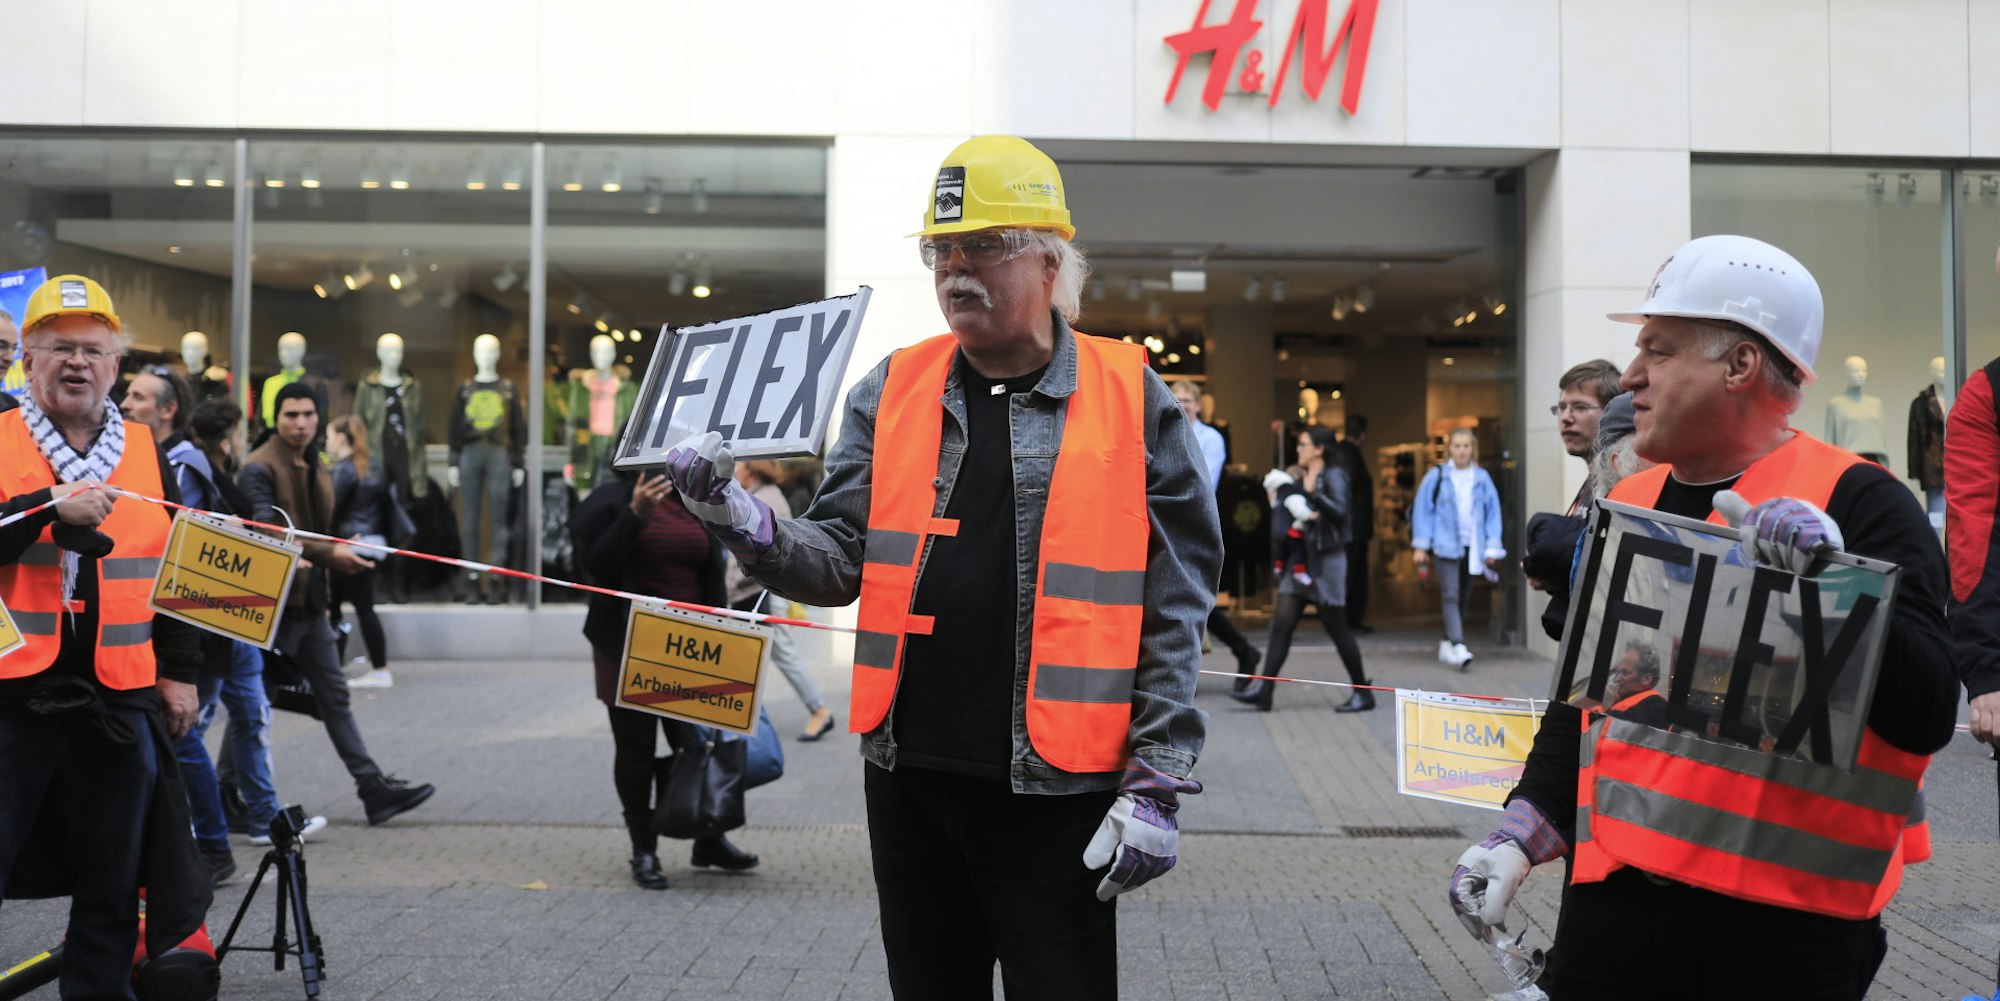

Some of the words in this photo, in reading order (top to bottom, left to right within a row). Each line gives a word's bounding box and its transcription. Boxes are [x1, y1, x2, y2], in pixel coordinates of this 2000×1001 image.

[1163, 0, 1379, 116] H&M
[652, 309, 851, 449] FLEX
[199, 542, 251, 578] H&M
[163, 578, 265, 625] Arbeitsrechte
[665, 633, 722, 665] H&M
[1587, 532, 1880, 766] FLEX
[631, 673, 744, 712] Arbeitsrechte
[1443, 720, 1505, 749] H&M
[1414, 760, 1521, 790] Arbeitsrech
